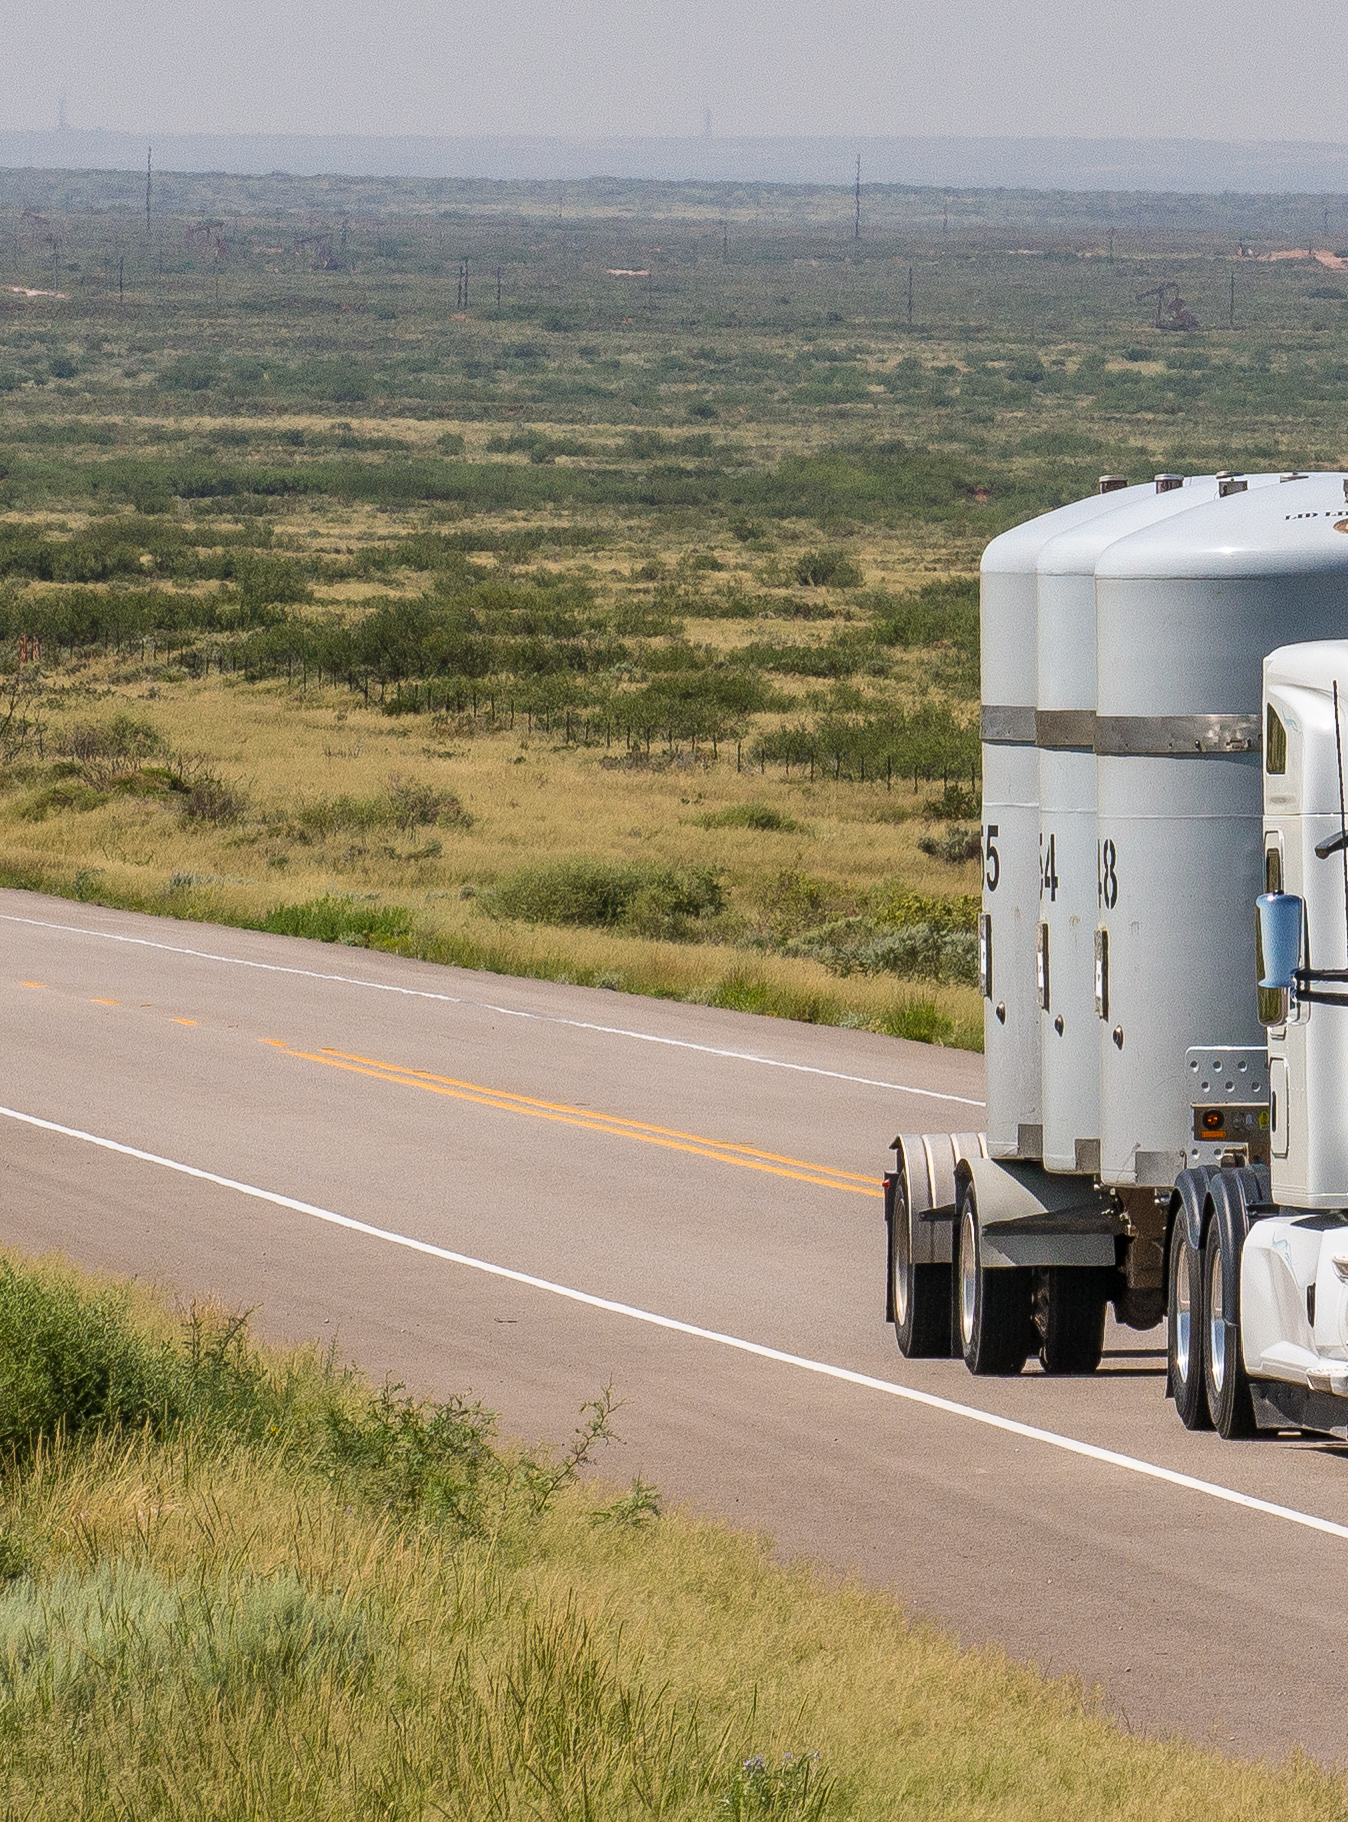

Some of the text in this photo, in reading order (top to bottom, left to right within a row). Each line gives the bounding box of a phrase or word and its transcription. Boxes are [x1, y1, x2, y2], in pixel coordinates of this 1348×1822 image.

[1285, 512, 1319, 520] LID
[981, 825, 1000, 892] 5
[1097, 839, 1118, 910] 8
